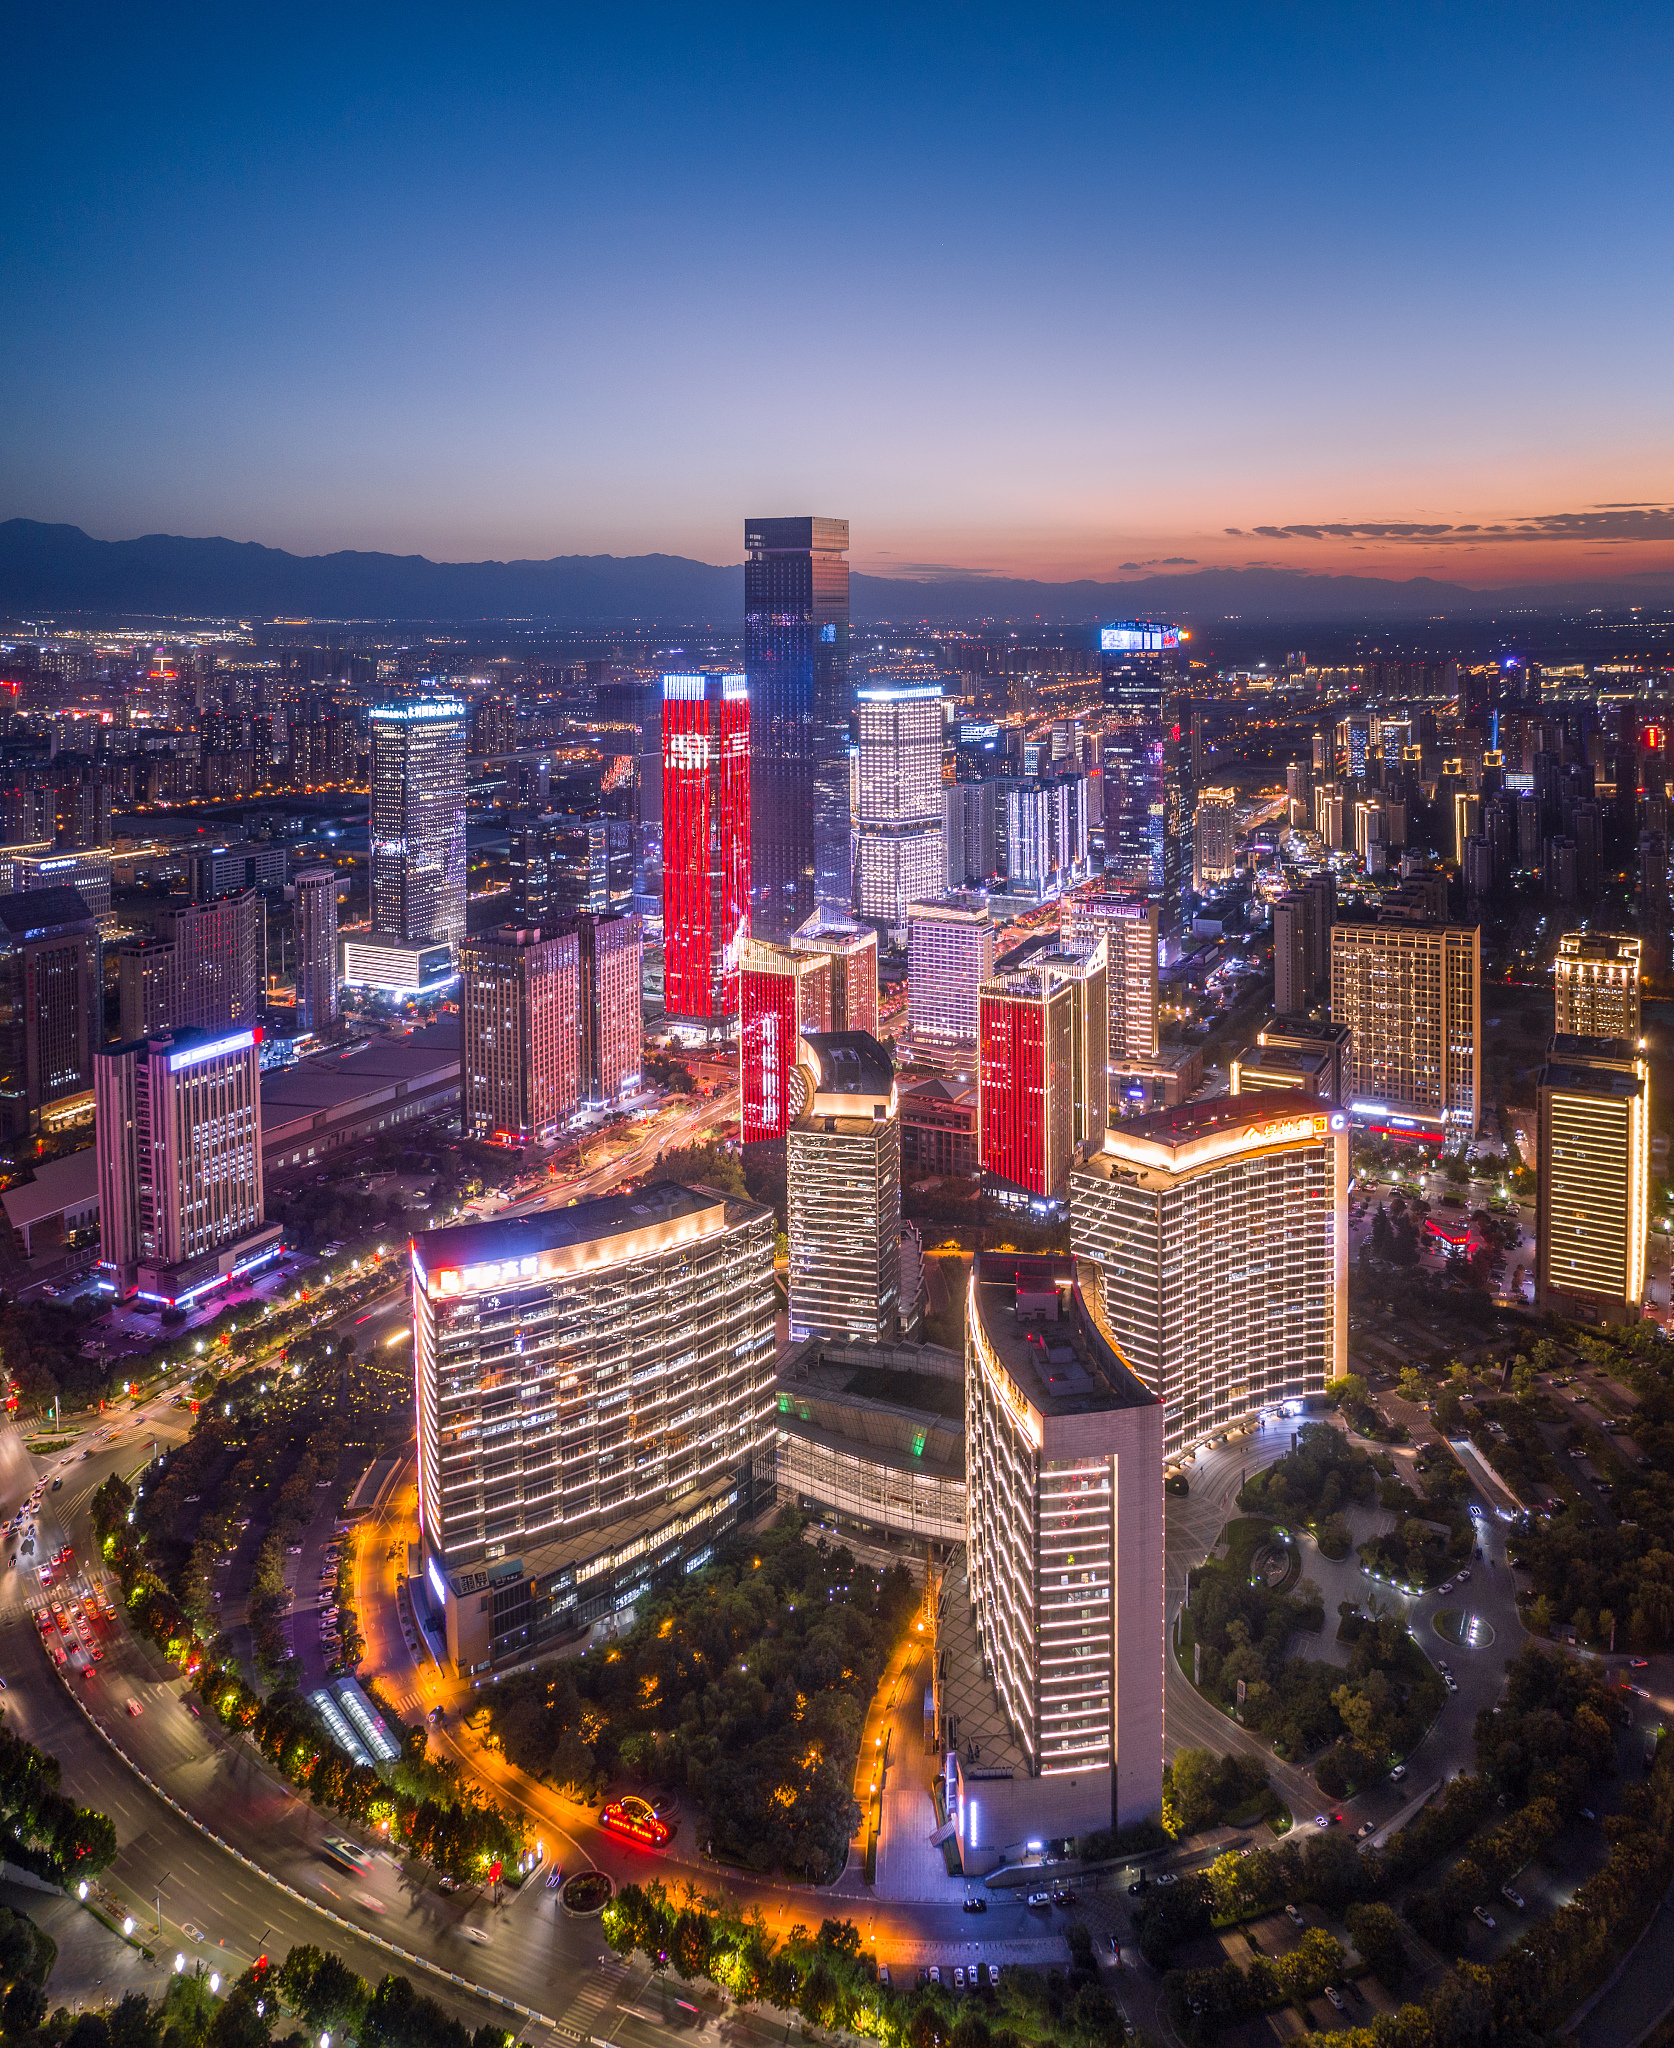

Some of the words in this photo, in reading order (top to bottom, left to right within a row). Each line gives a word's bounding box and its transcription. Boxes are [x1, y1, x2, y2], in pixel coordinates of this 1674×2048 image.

[1264, 1115, 1328, 1139] 绿地集团
[1331, 1114, 1344, 1130] C
